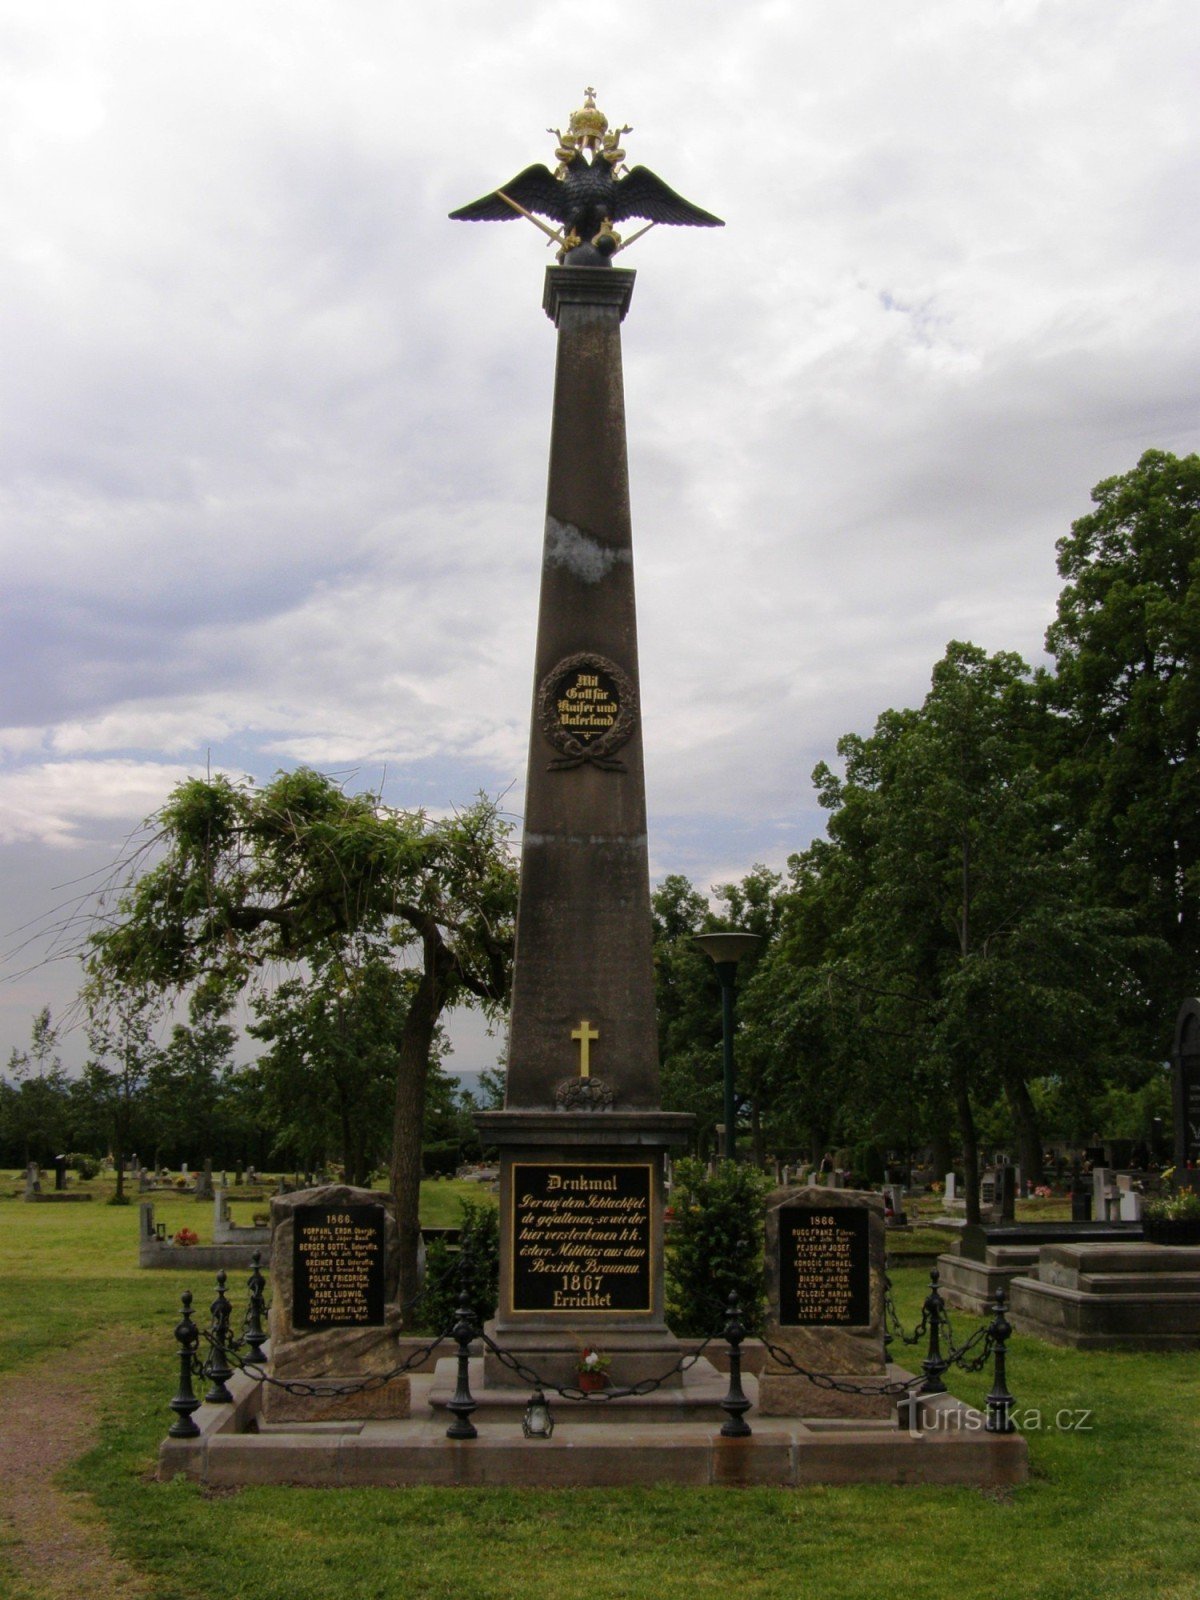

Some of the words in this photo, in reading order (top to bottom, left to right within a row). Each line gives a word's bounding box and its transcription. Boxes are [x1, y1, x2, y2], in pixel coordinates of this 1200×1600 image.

[576, 675, 599, 687] Mit
[566, 688, 592, 699] Gott
[596, 702, 617, 712] und
[560, 714, 614, 726] Vaterland
[546, 1175, 617, 1192] Denkmal
[519, 1195, 542, 1208] Der
[542, 1197, 561, 1212] auf
[562, 1197, 585, 1208] dem
[522, 1213, 534, 1224] de
[610, 1213, 628, 1224] wie
[628, 1213, 646, 1224] der
[519, 1228, 543, 1240] hier
[544, 1229, 617, 1241] verstorbenen
[603, 1247, 622, 1256] aus
[623, 1245, 645, 1256] dem
[528, 1259, 579, 1273] Bezirke
[562, 1275, 603, 1290] 1867
[554, 1291, 611, 1307] Errichtet
